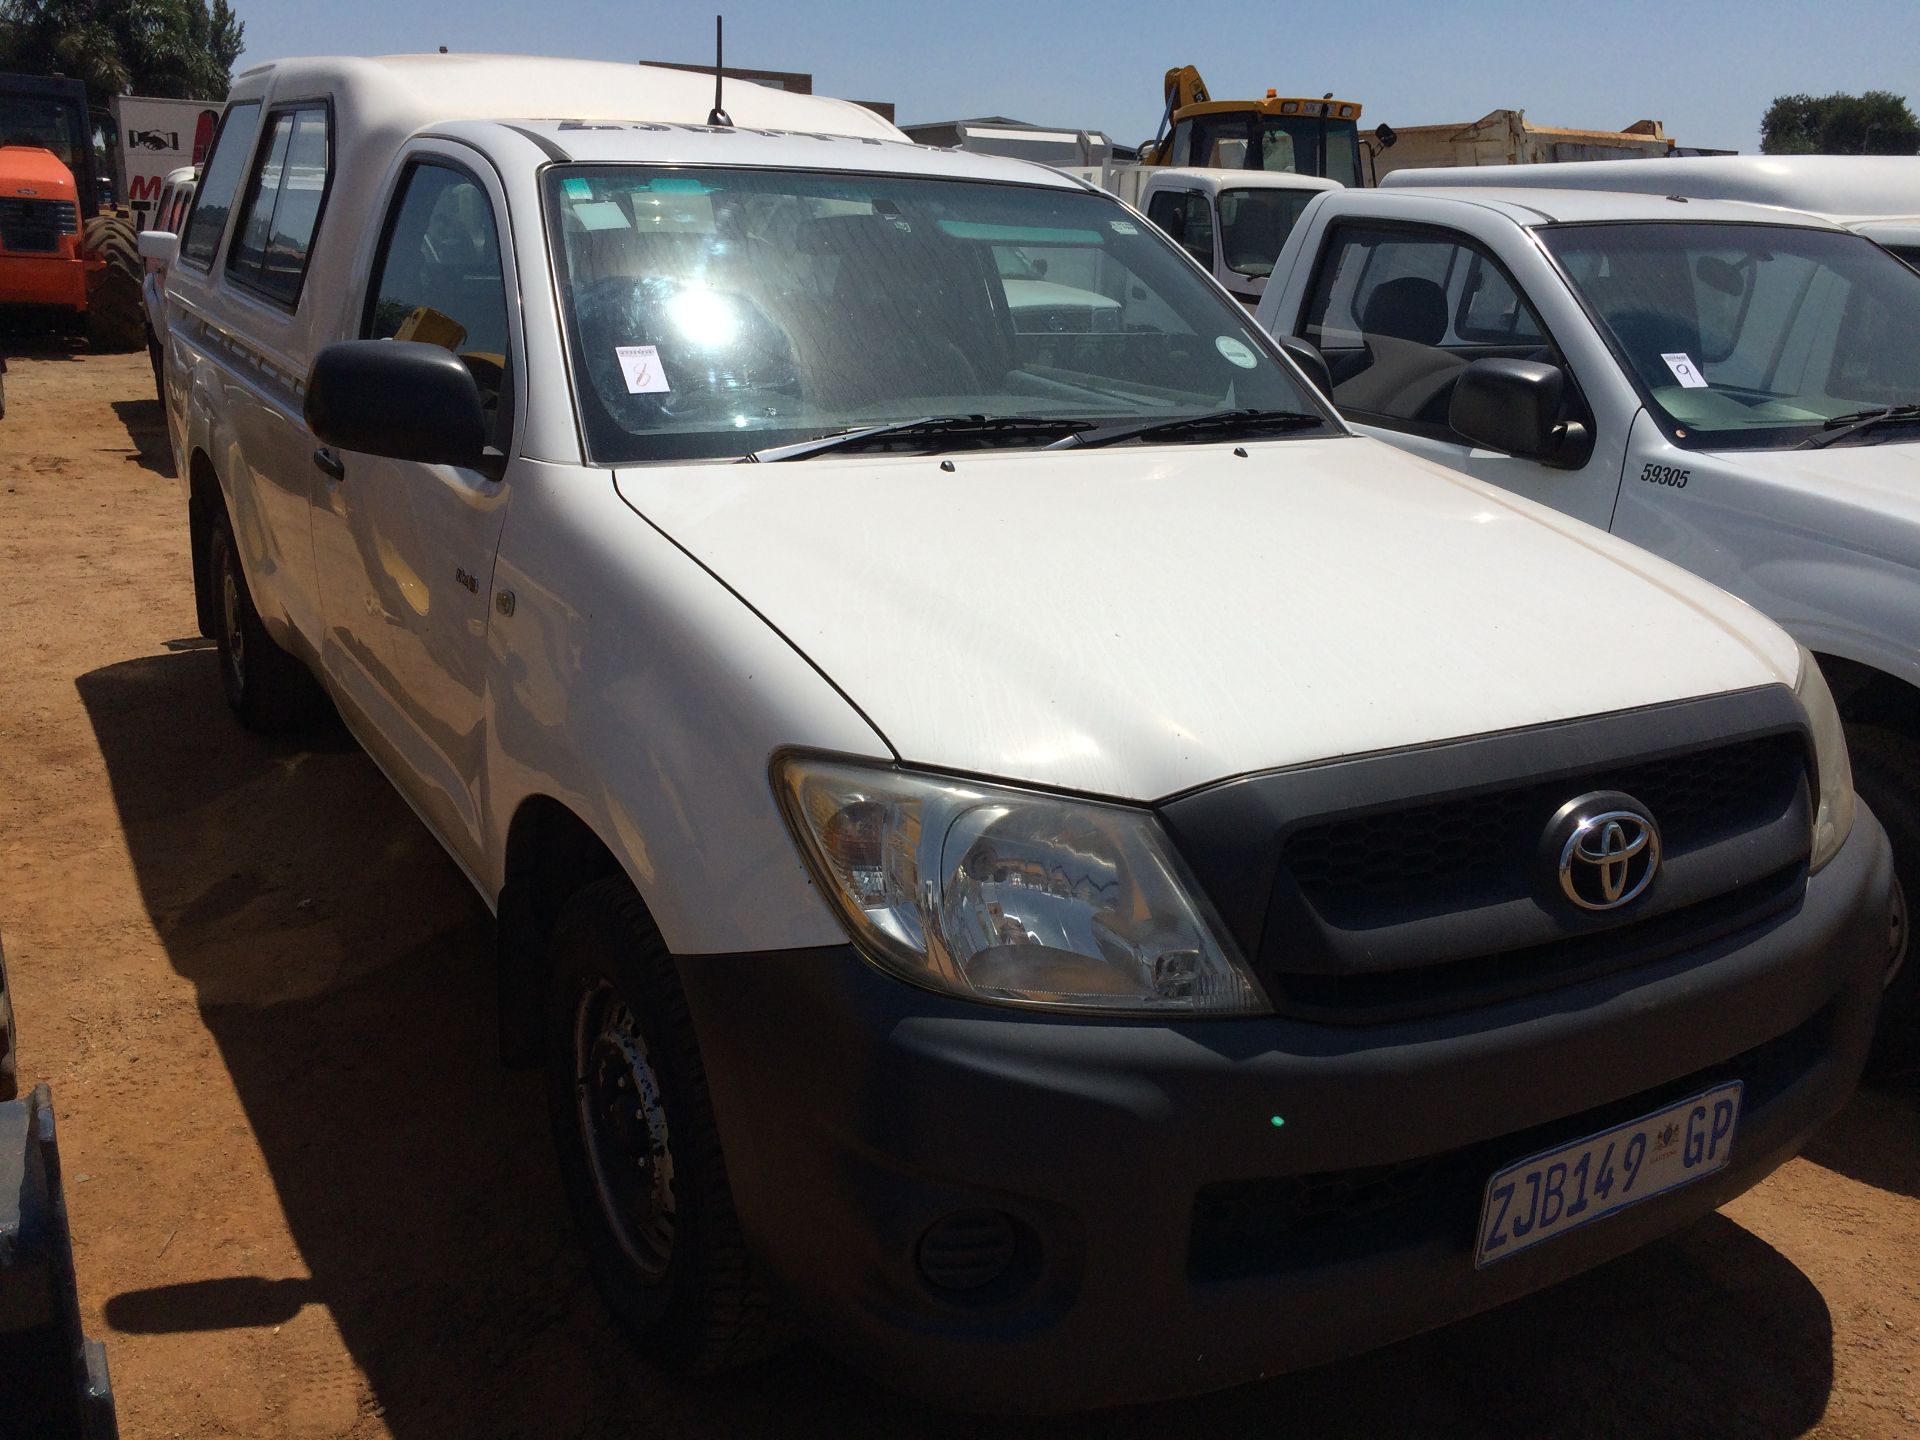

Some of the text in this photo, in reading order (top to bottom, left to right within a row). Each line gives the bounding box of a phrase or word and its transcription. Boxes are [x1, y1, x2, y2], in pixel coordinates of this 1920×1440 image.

[1676, 364, 1695, 383] 9
[1640, 463, 1691, 489] 59305
[1484, 1099, 1733, 1252] ZJB149 GP
